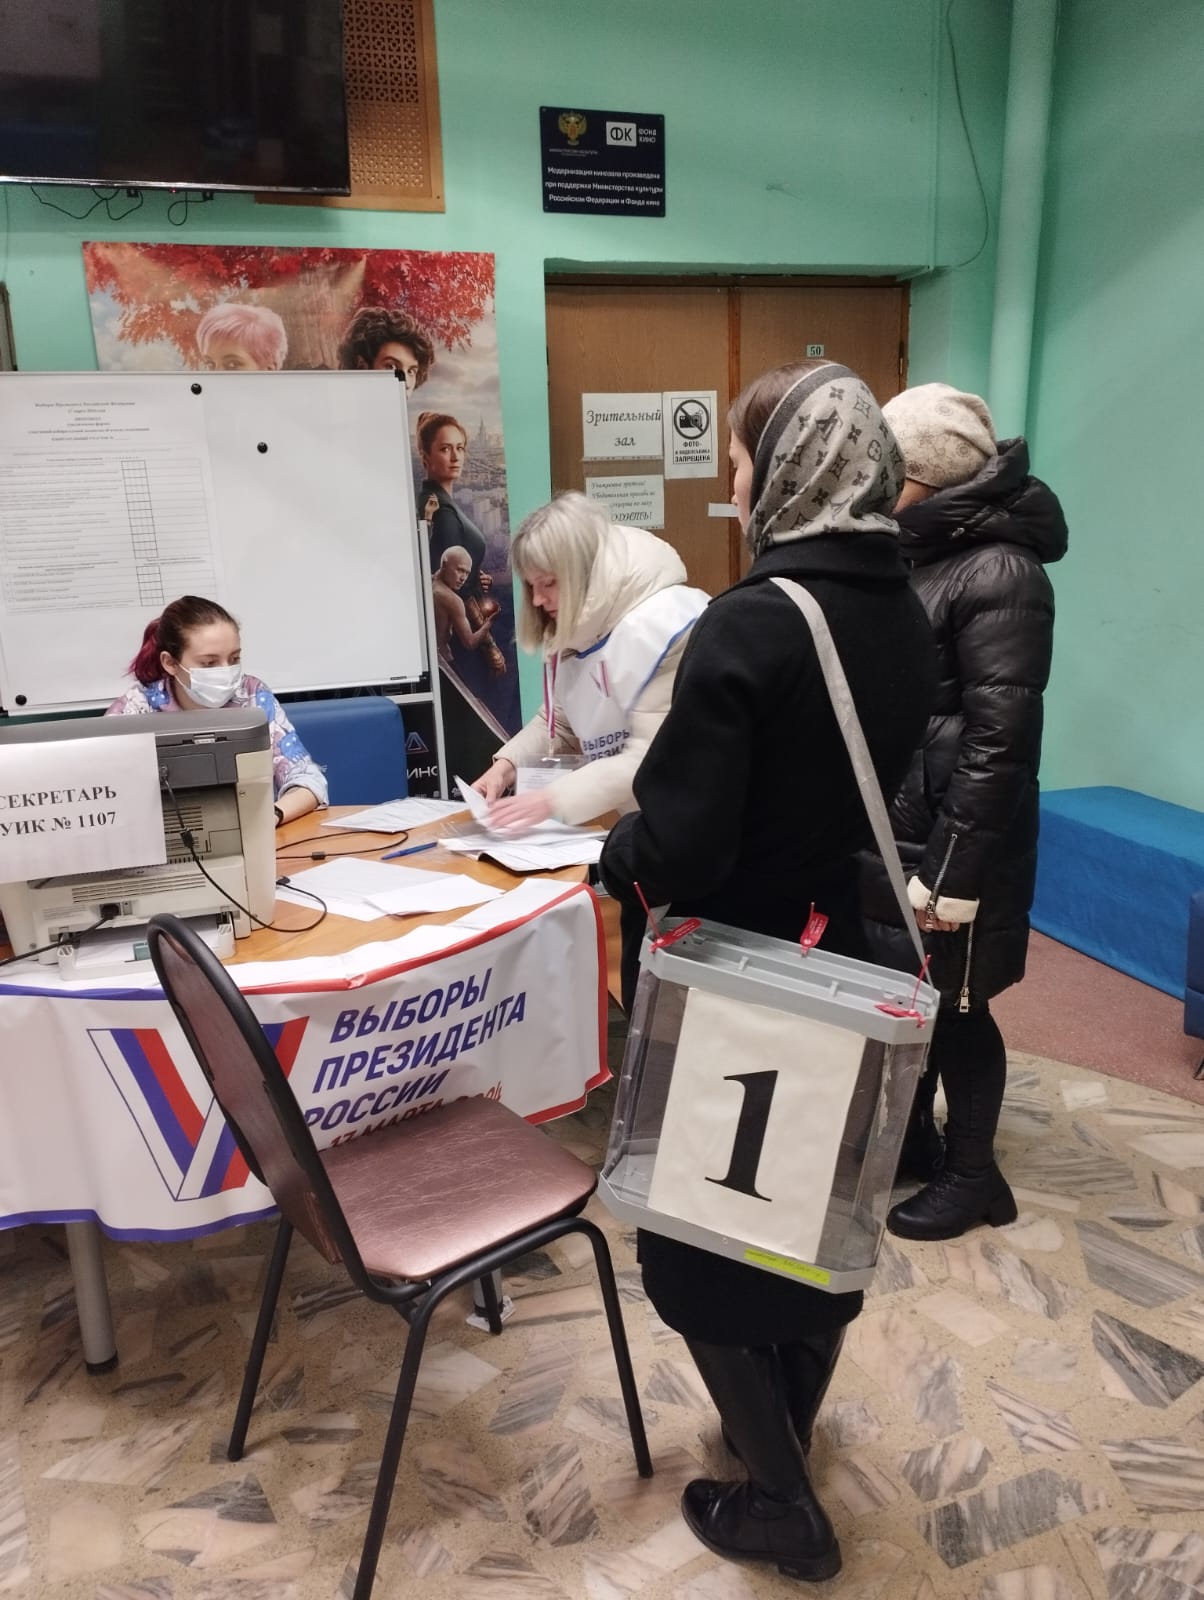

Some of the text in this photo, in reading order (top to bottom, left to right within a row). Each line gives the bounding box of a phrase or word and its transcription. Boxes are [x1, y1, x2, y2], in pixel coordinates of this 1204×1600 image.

[610, 127, 632, 141] ФК
[810, 346, 821, 356] 50
[586, 409, 661, 427] Зрительный
[614, 437, 636, 446] зал
[675, 455, 711, 463] ЗАПРЕЩЕНА
[0, 811, 116, 837] УИК № 1107
[329, 967, 492, 1043] ВЫБОРЫ
[312, 992, 527, 1094] ПРЕЗИДЕНТА
[303, 1068, 450, 1132] РОССИИ
[704, 1070, 779, 1202] 1
